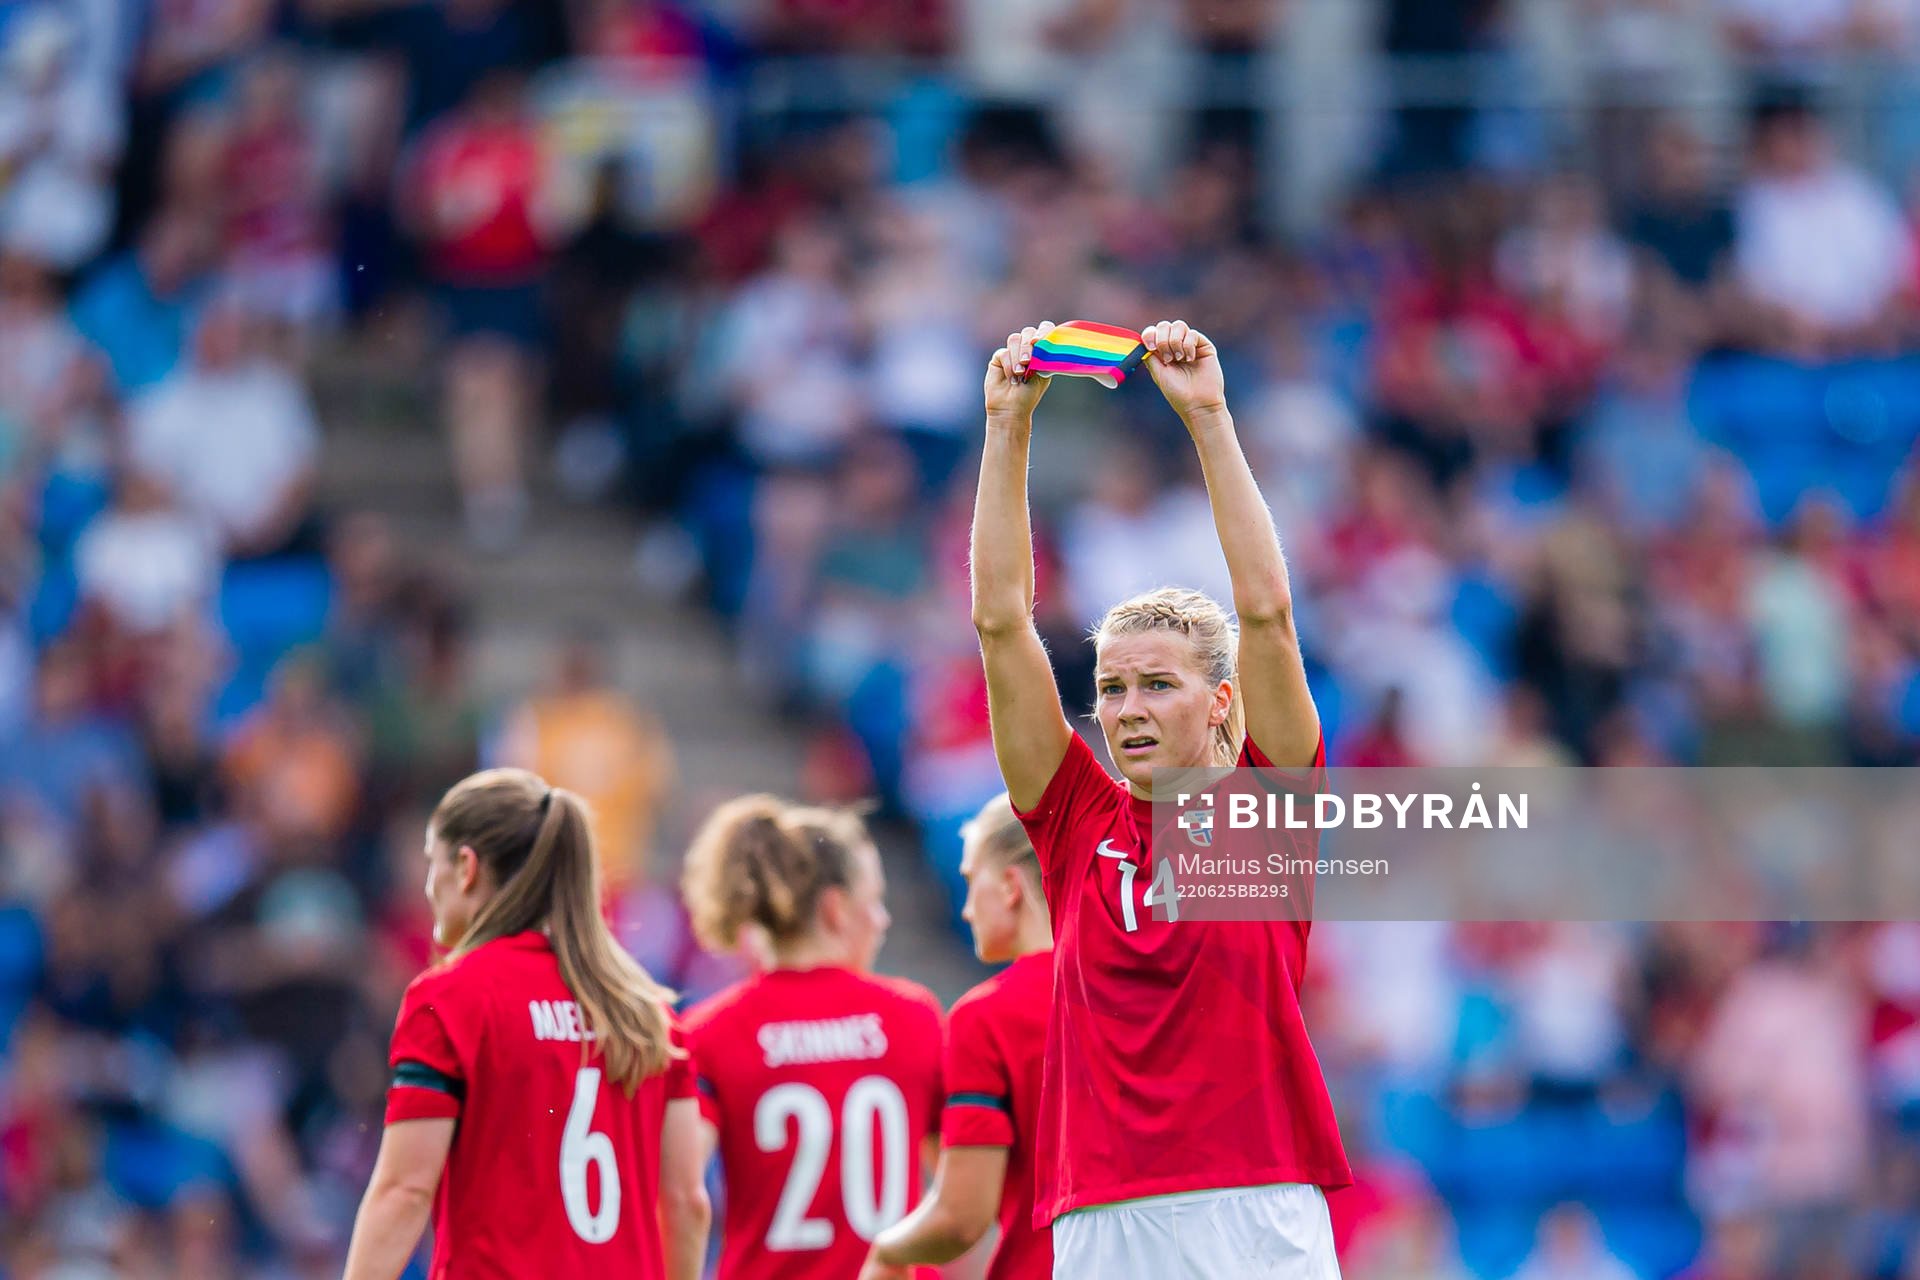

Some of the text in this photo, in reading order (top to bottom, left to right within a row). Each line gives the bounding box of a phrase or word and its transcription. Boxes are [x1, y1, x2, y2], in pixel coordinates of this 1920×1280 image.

[1118, 857, 1181, 931] 14
[560, 1067, 621, 1243] 6
[754, 1075, 909, 1251] 20
